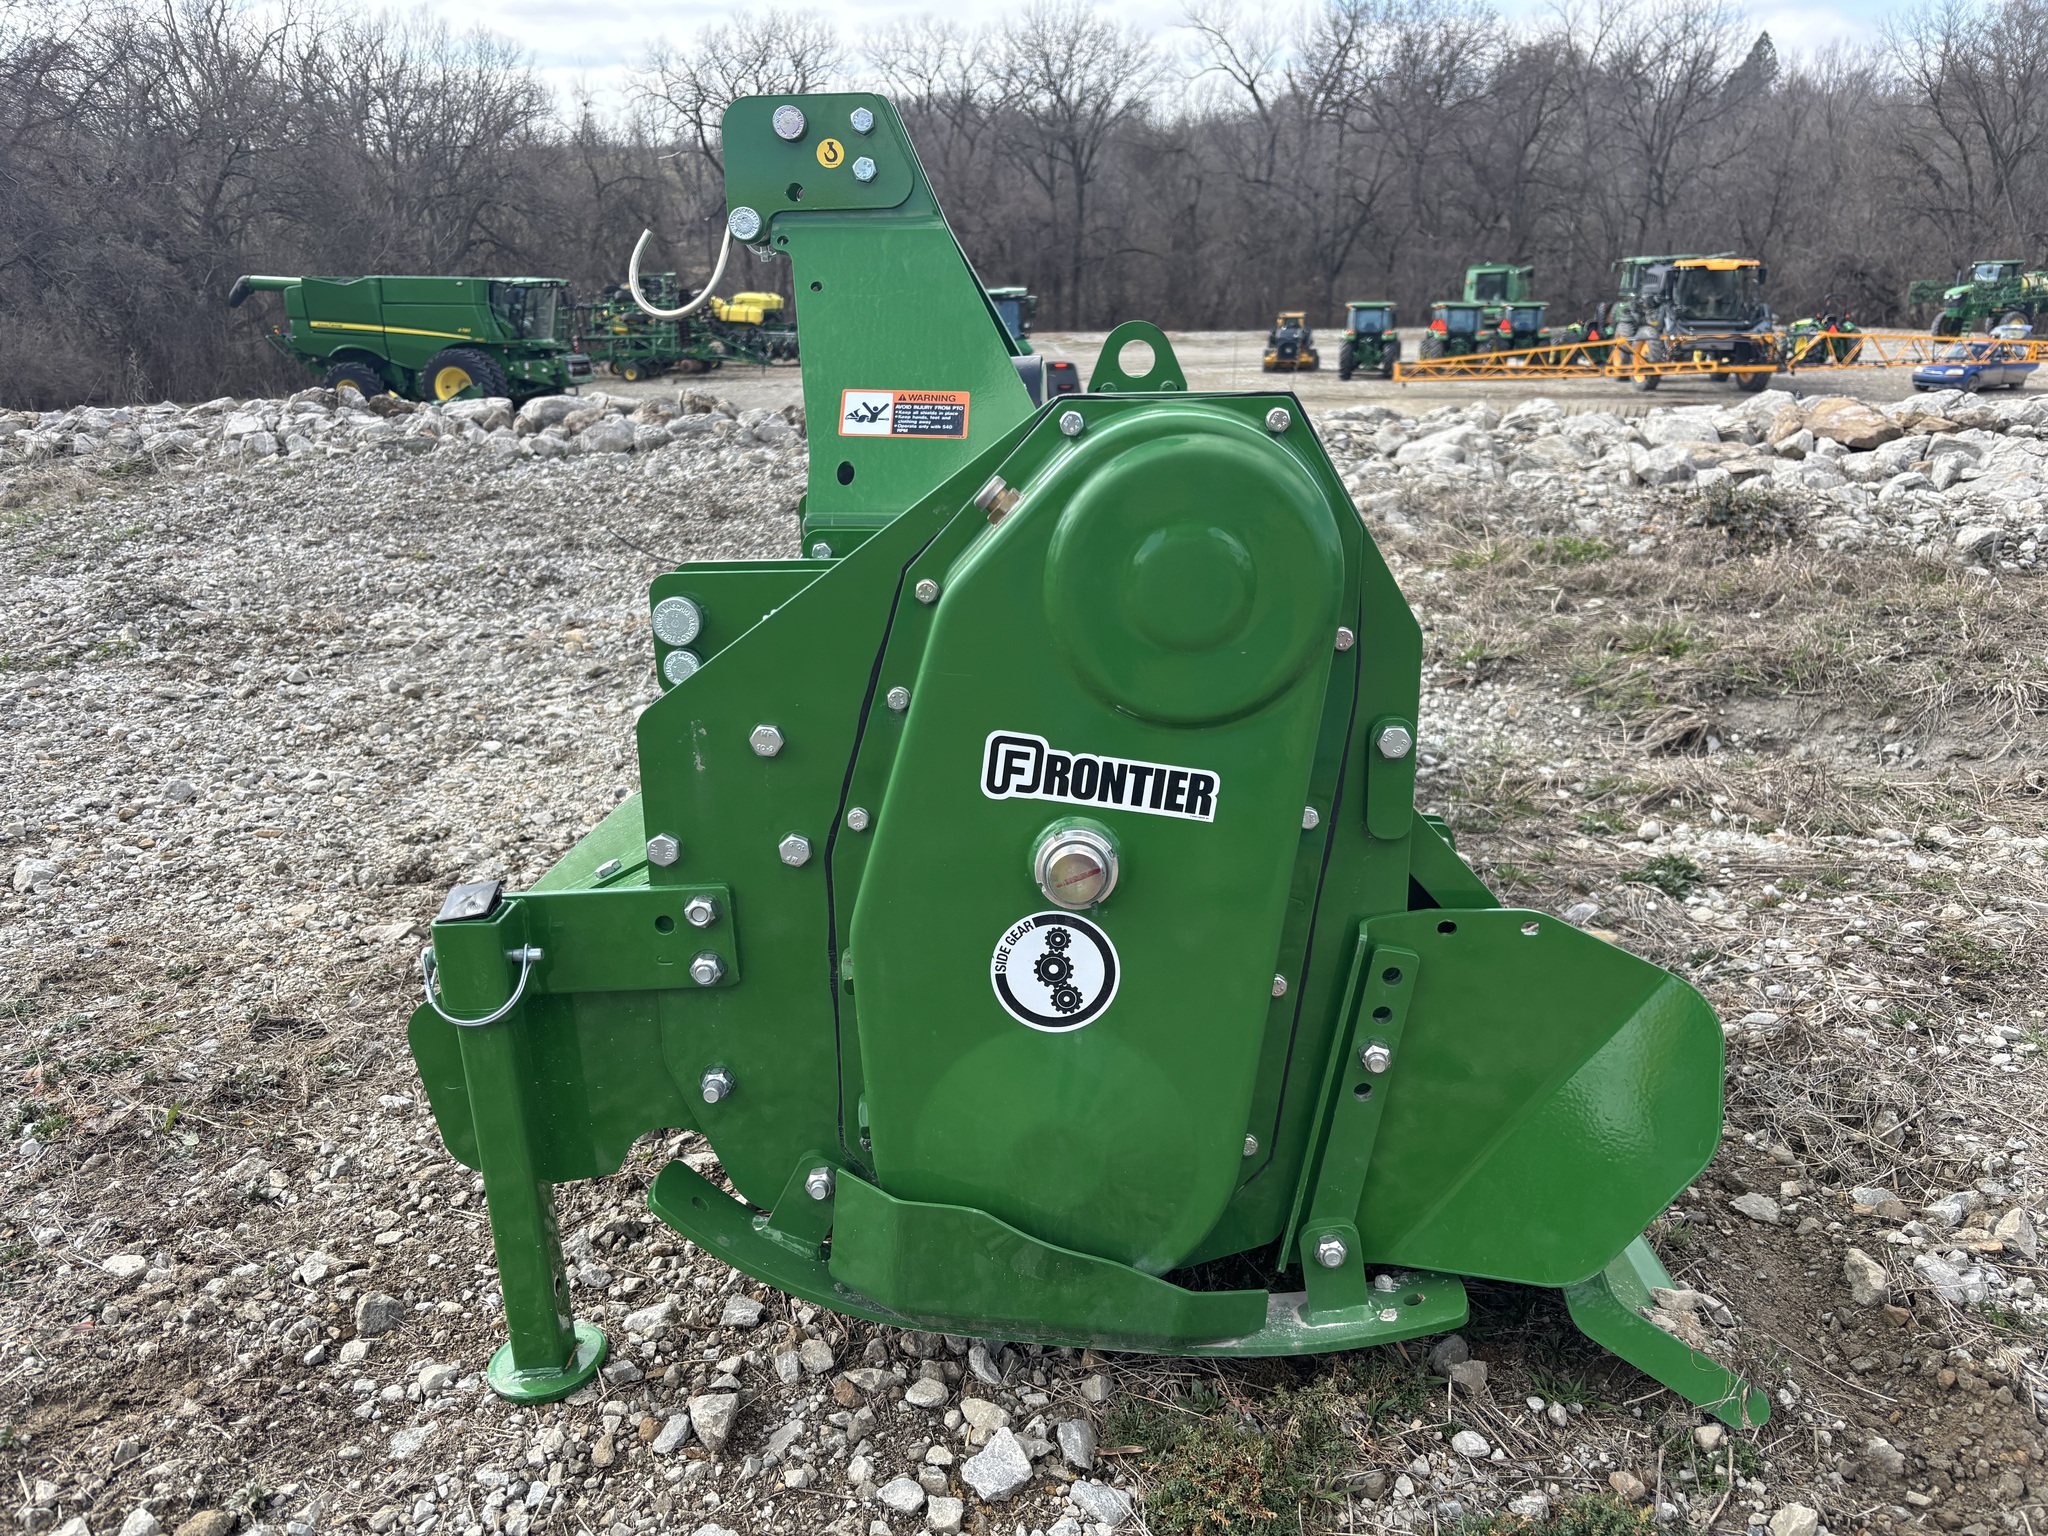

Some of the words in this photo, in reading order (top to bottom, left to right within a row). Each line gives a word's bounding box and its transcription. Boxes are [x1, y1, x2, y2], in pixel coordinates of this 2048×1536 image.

[908, 394, 957, 402] WARNING
[986, 735, 1215, 816] FRONTIER
[994, 945, 1012, 973] SIDE
[1005, 920, 1035, 946] GEAR
